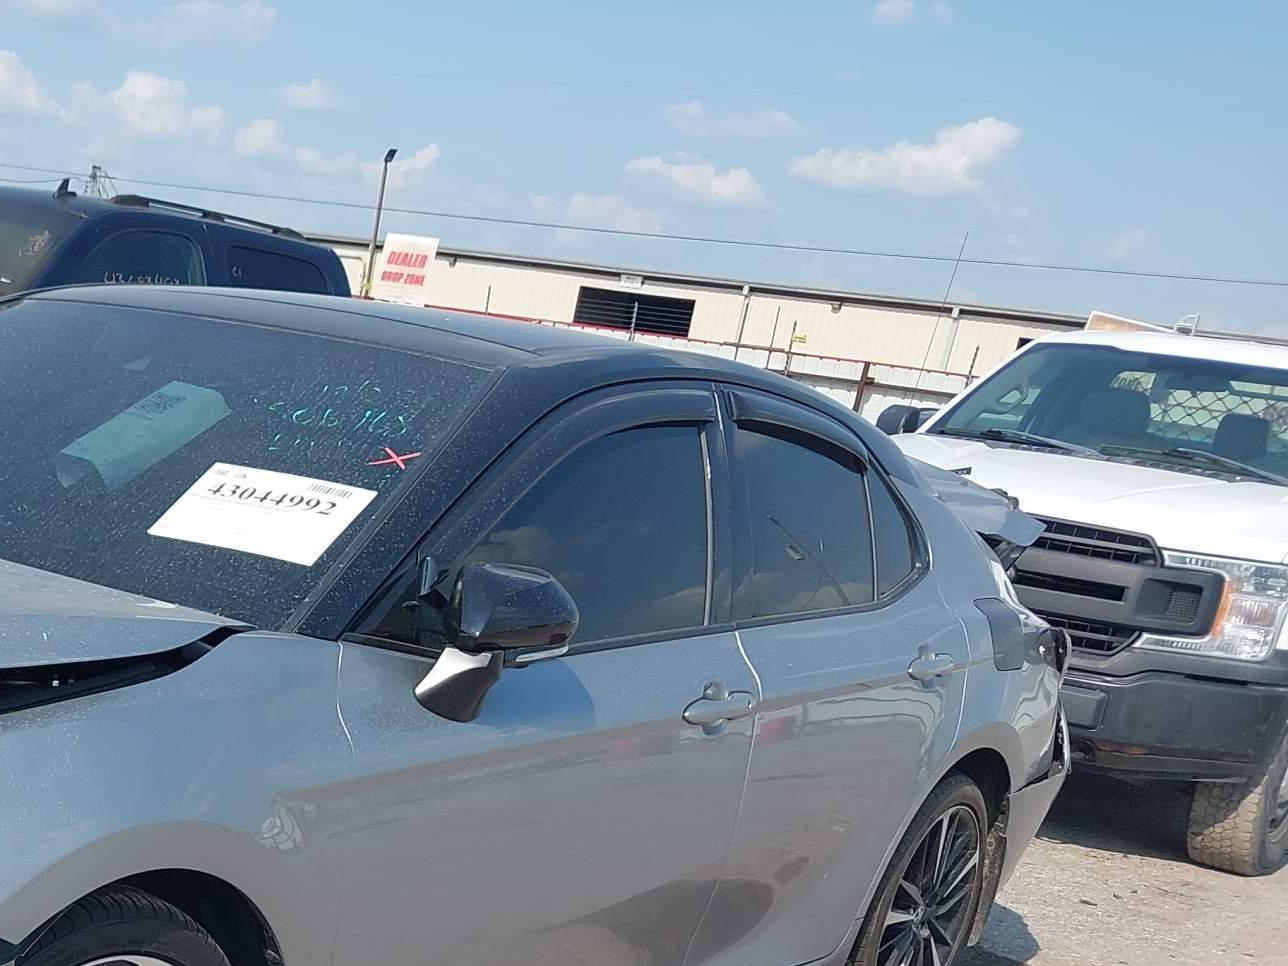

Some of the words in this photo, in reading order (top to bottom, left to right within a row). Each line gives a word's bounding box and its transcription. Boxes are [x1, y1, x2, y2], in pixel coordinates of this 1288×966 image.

[387, 251, 428, 268] DEALER
[381, 270, 404, 283] DROP
[404, 273, 425, 286] ZONE
[207, 482, 337, 515] 43044992
